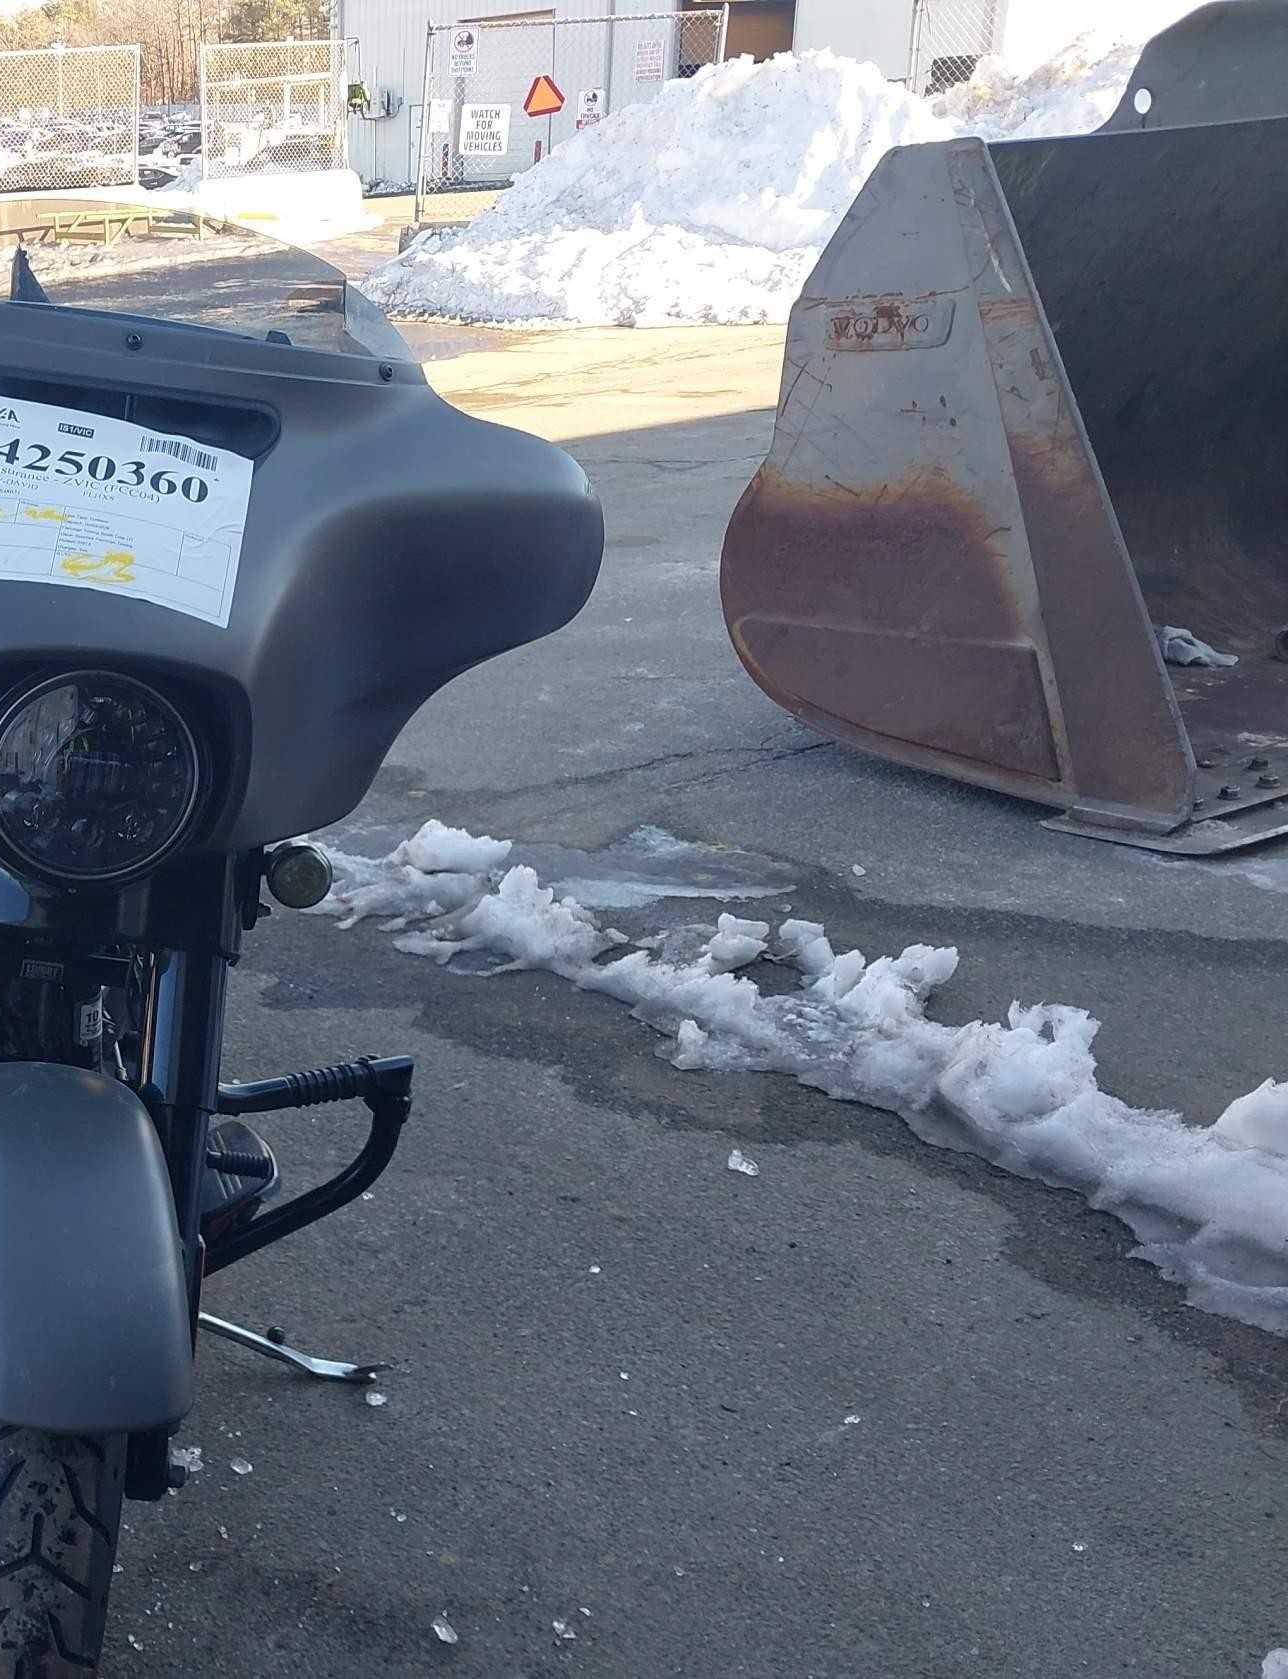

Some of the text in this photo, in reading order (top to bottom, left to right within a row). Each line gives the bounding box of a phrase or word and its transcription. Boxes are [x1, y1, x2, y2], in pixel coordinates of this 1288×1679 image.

[471, 109, 501, 119] WATCH
[476, 120, 492, 129] FOR
[466, 131, 501, 141] MOVING
[463, 141, 503, 151] VEHICLES
[832, 314, 929, 337] VOLVO
[64, 478, 101, 490] ZVIC
